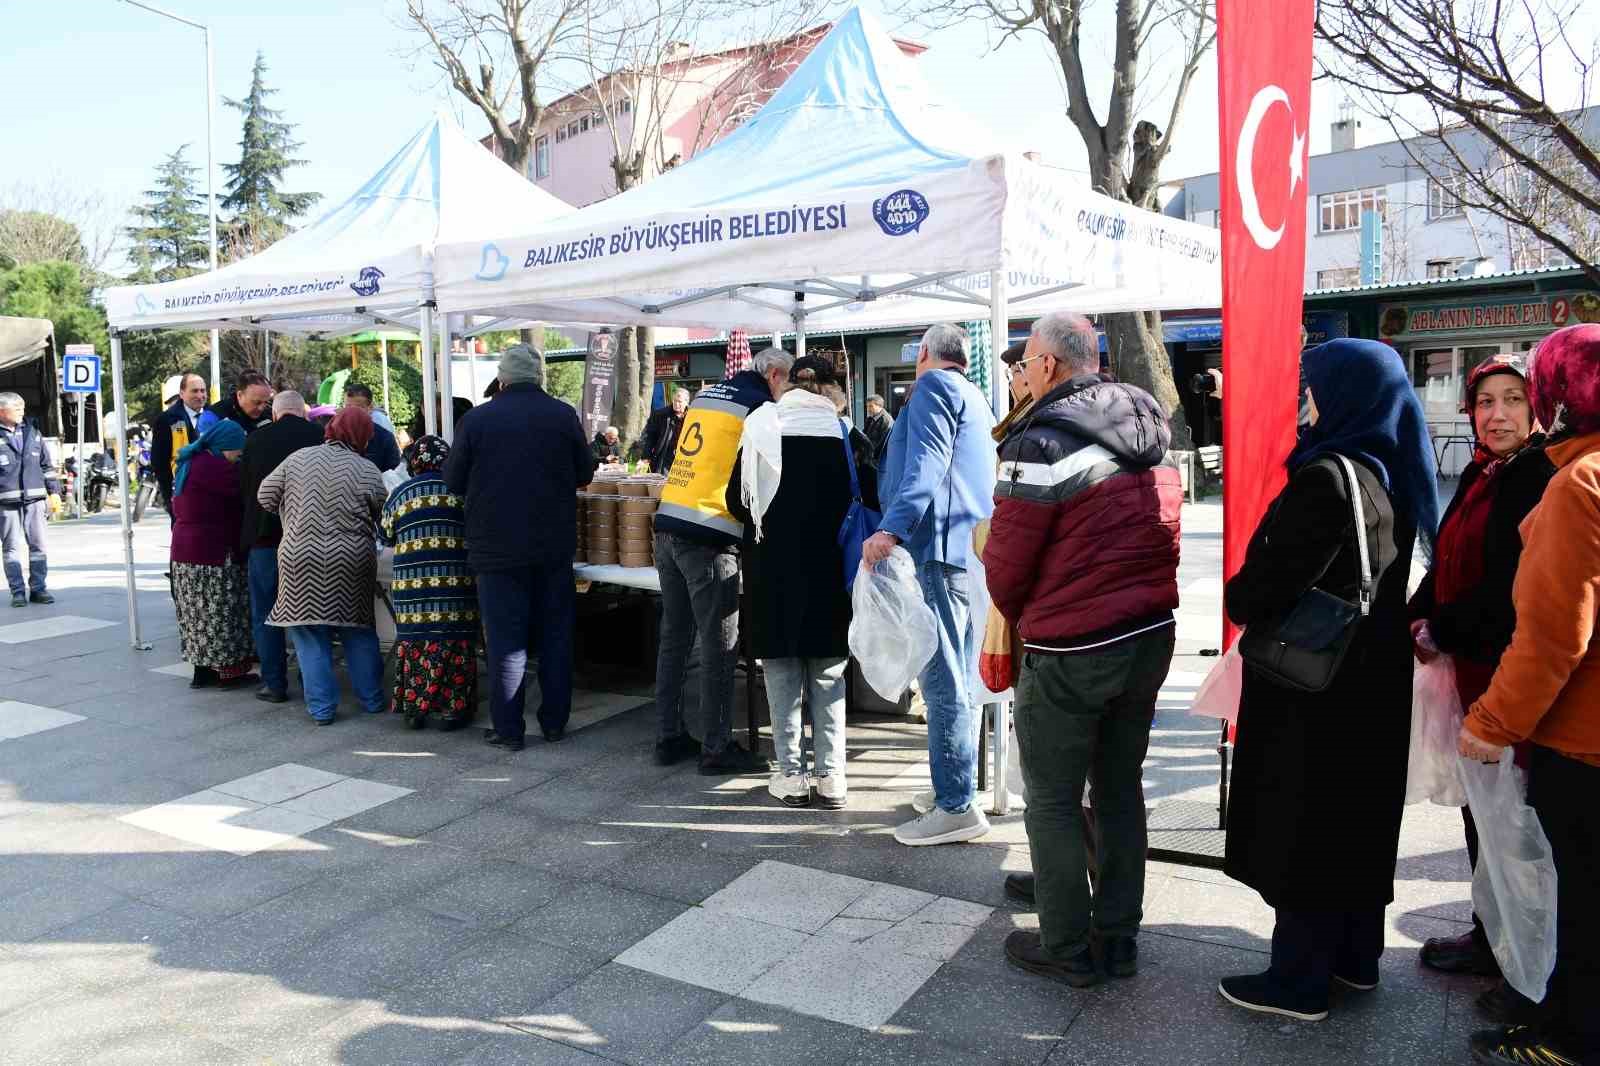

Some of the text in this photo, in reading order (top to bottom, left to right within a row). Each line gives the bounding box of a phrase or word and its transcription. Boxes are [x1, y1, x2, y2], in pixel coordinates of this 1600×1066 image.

[887, 198, 911, 211] 444
[524, 233, 605, 268] BALIKESİR
[609, 213, 723, 256] BÜYÜKŞEHİR
[729, 201, 847, 240] BELEDİYESİ
[1474, 304, 1519, 326] BALIK
[1553, 301, 1566, 322] 2
[75, 365, 89, 383] D
